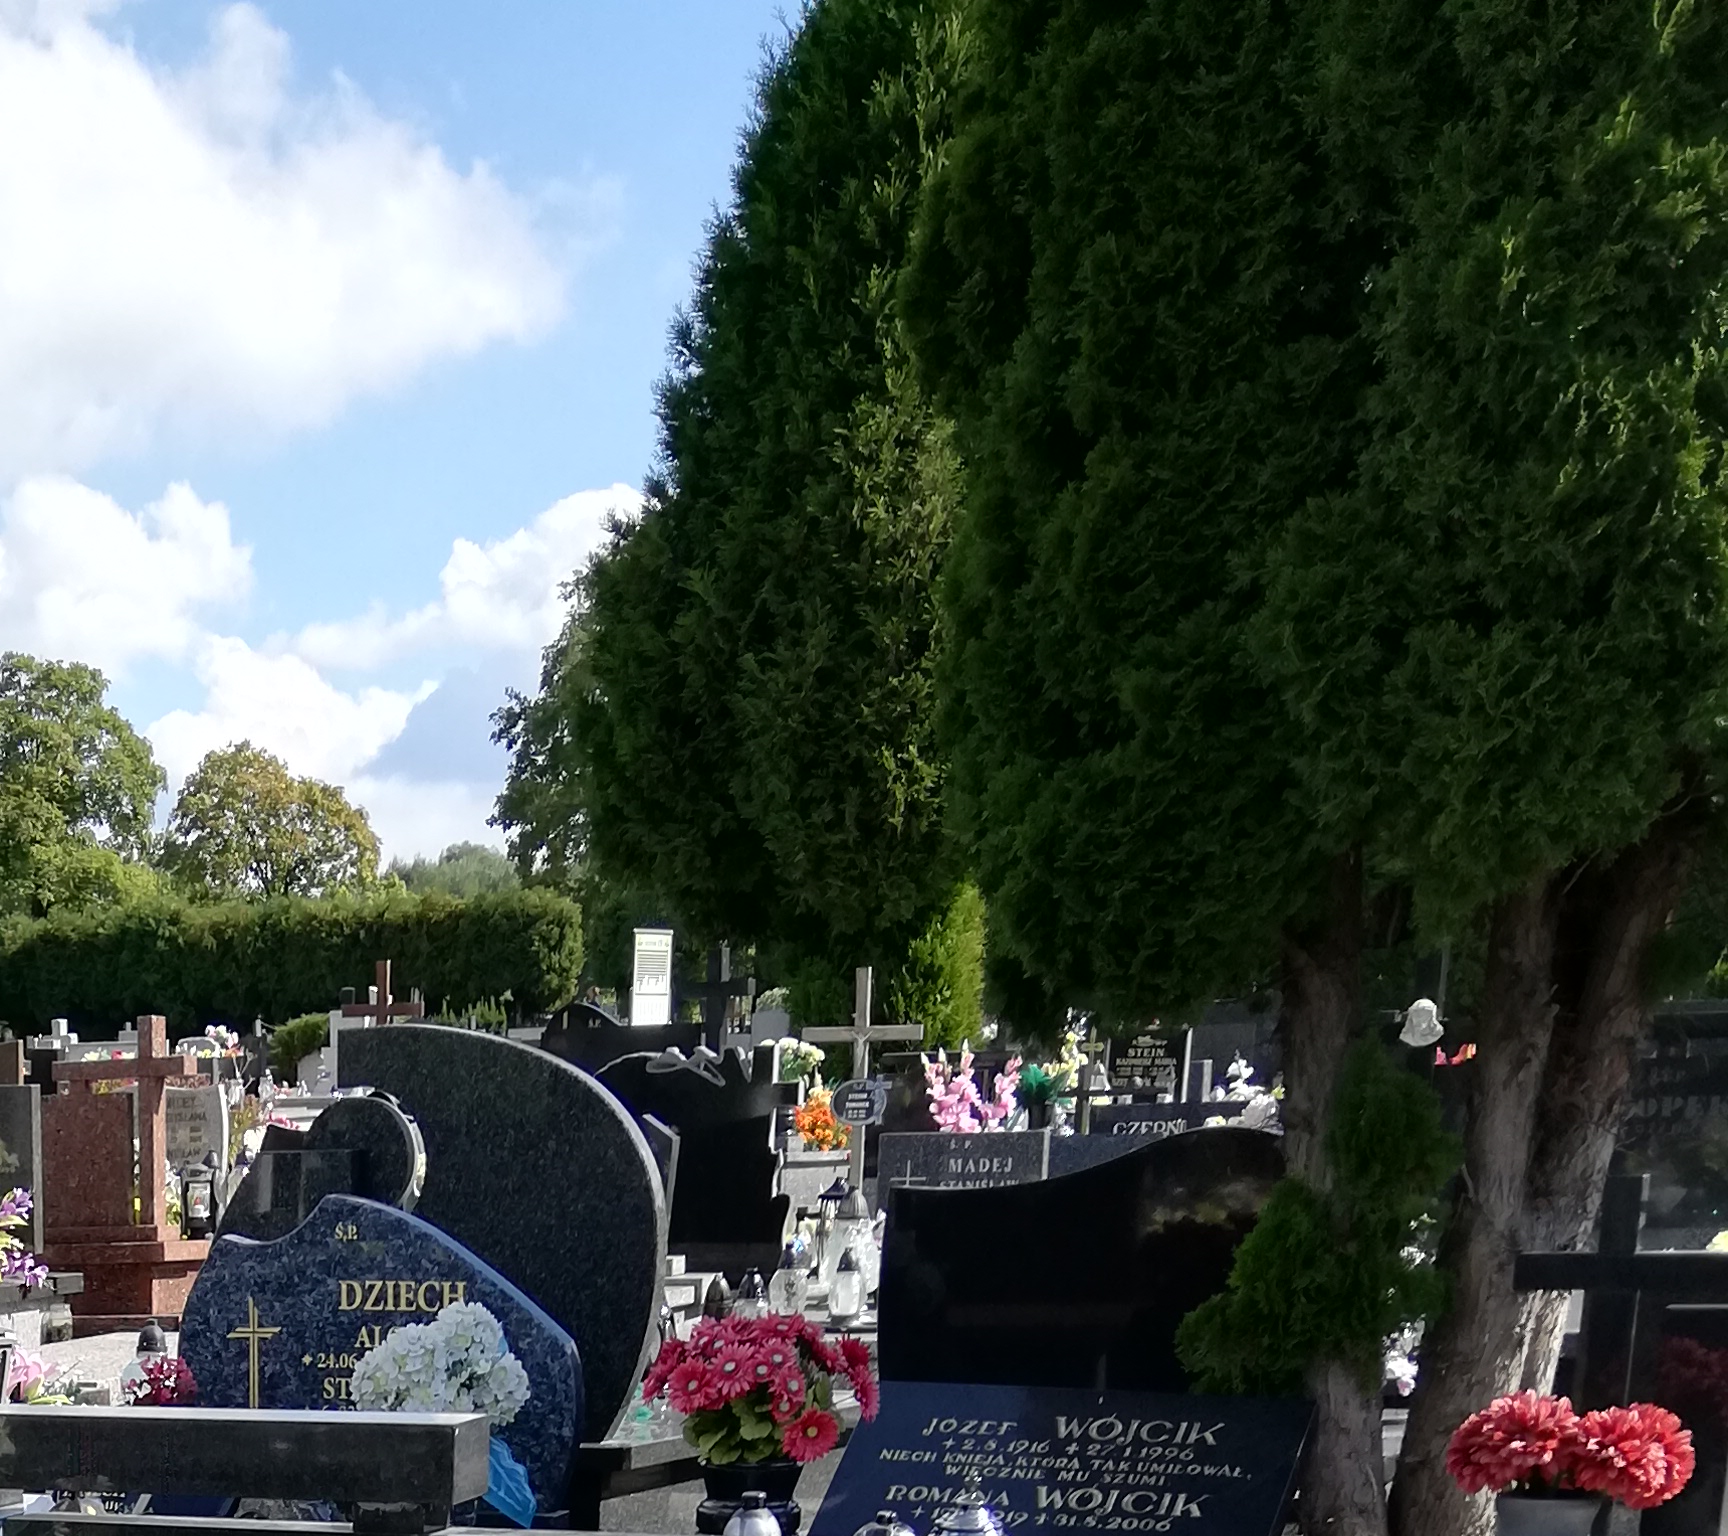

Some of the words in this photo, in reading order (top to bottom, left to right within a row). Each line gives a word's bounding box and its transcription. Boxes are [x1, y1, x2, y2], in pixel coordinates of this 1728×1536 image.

[1127, 1047, 1166, 1057] STEIN
[948, 1157, 1014, 1174] MADEJ
[338, 1280, 467, 1311] DZIECH
[922, 1416, 1019, 1437] JÓZEF
[1055, 1413, 1227, 1447] WÓJCIK
[879, 1448, 938, 1464] NIECH
[1089, 1459, 1131, 1474] TAK
[1056, 1468, 1091, 1485] MU
[1036, 1482, 1211, 1519] WÓJCIK
